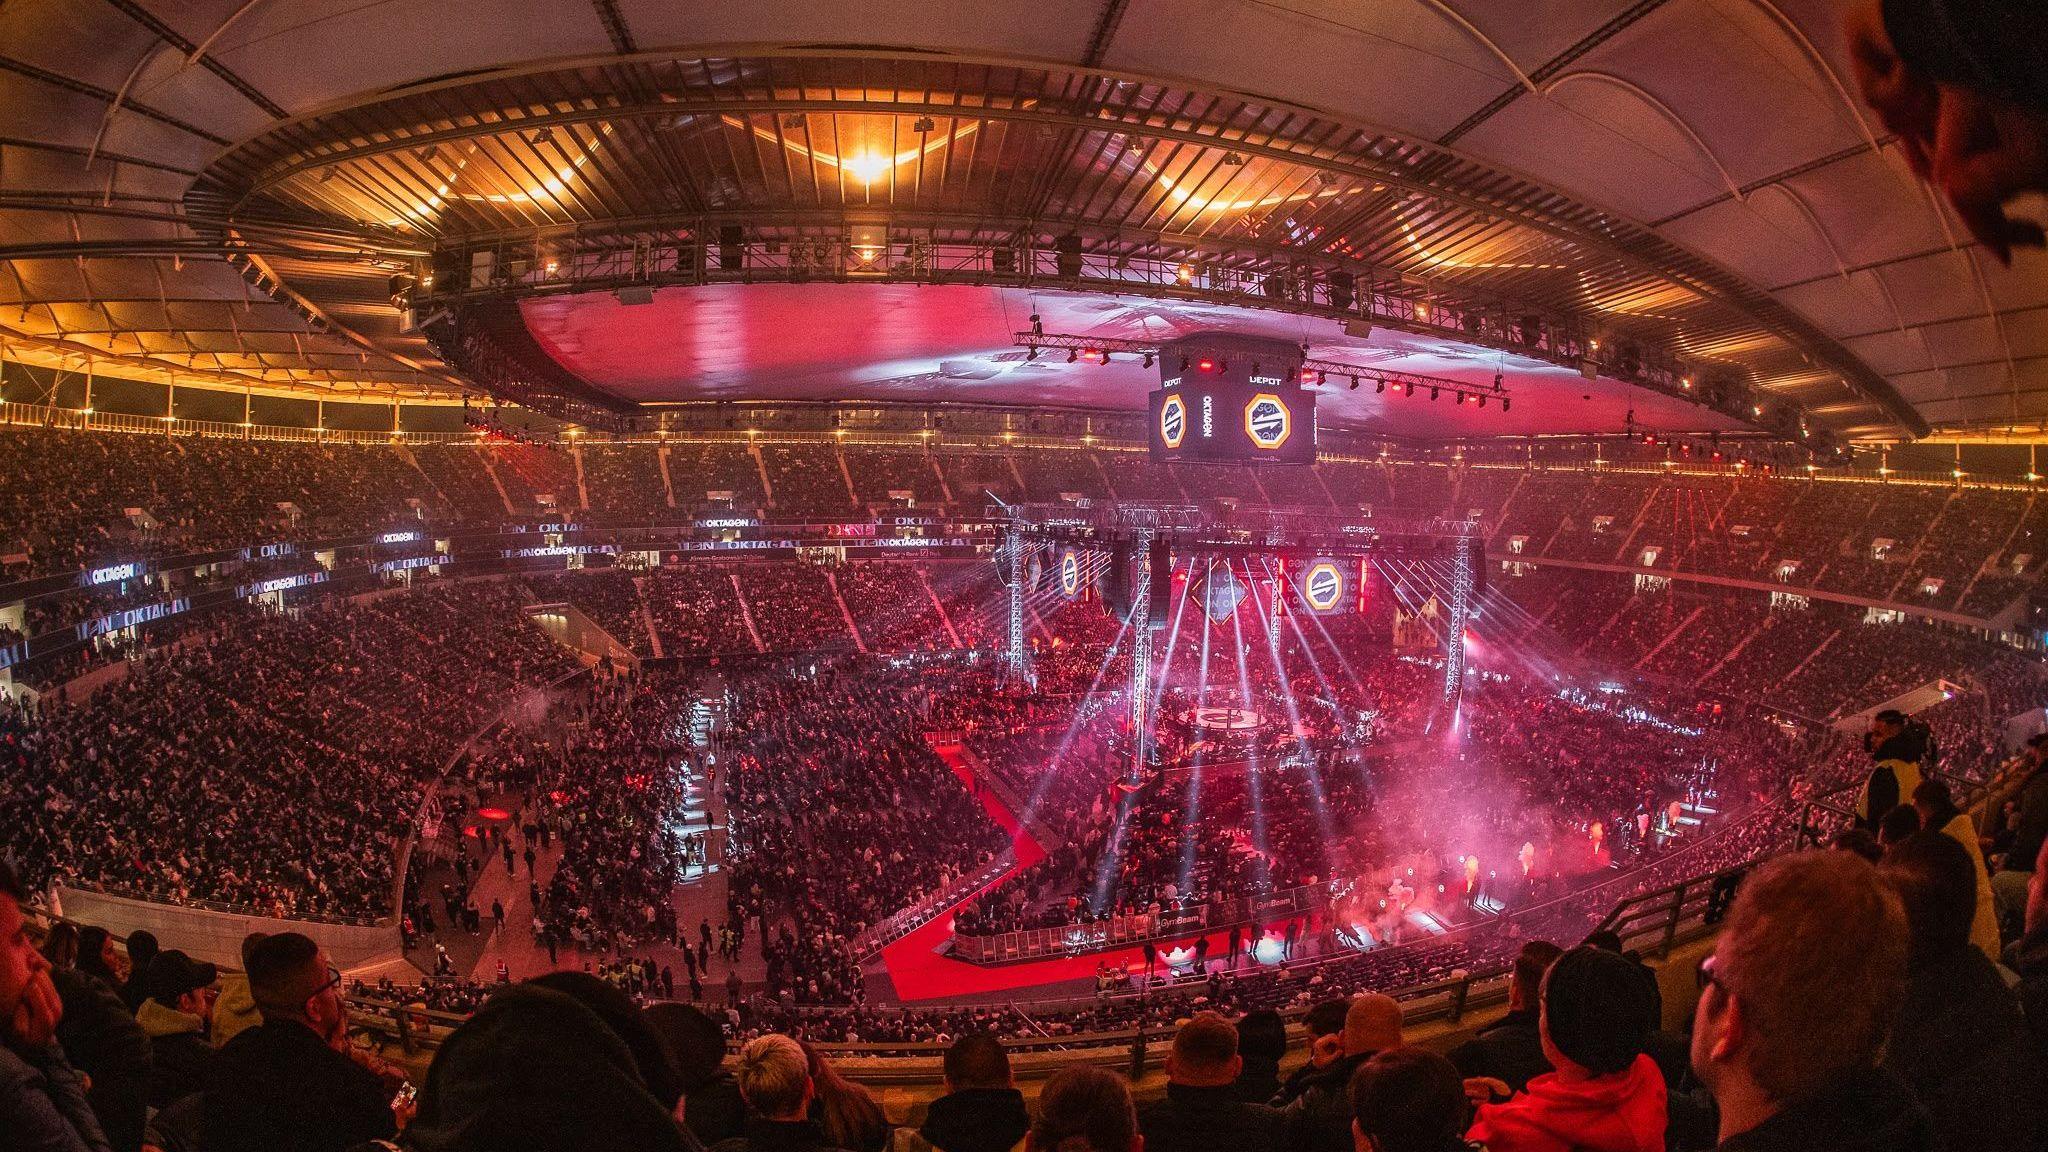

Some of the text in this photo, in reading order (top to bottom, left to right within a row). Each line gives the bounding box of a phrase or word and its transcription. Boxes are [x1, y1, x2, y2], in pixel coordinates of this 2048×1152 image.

[1164, 378, 1181, 388] DEPOT
[1249, 376, 1281, 385] DEPOT
[1203, 396, 1212, 437] OKTAGON
[706, 519, 748, 527] OKTAGON
[383, 532, 414, 543] OKTAGON
[889, 539, 928, 547] OKTAGON
[534, 546, 576, 556] OKTAGON
[93, 564, 134, 584] OKTAGON
[263, 576, 297, 592] OKTAGON
[1257, 898, 1291, 910] GymBeam
[1161, 915, 1199, 928] GymBeam
